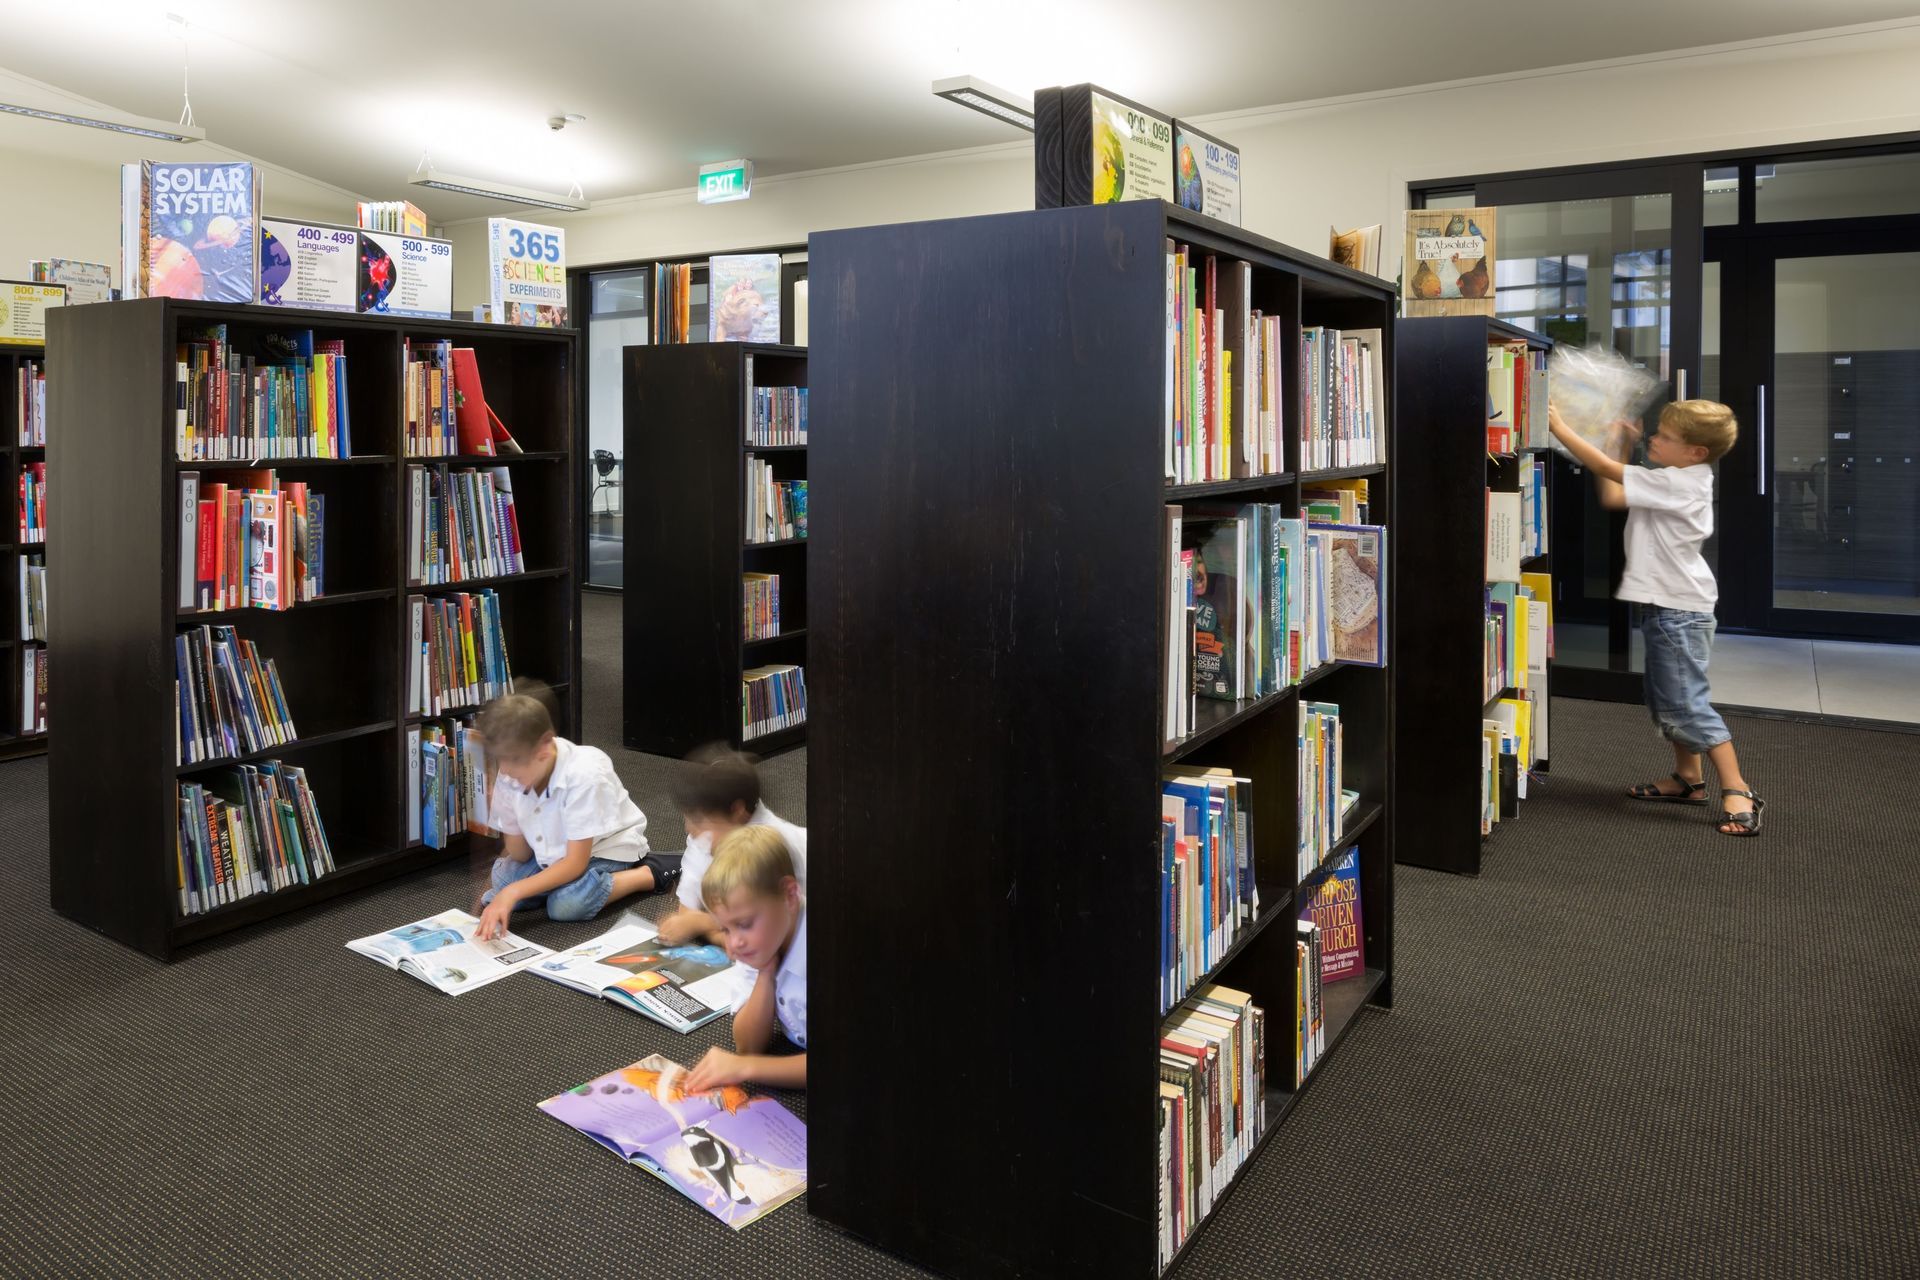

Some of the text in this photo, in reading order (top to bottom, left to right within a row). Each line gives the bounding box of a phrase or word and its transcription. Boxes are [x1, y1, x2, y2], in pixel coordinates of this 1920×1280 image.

[1153, 122, 1169, 143] 099
[1205, 144, 1220, 163] 100
[1225, 152, 1238, 170] 199
[155, 167, 247, 193] SOLAR
[706, 173, 736, 194] EXIT
[155, 192, 247, 215] SYSTEM
[297, 227, 321, 241] 400
[331, 232, 354, 245] 499
[297, 240, 340, 253] Languages
[509, 229, 560, 263] 365
[1419, 240, 1480, 251] It's Absolutely
[402, 241, 422, 253] 500
[431, 245, 449, 257] 599
[402, 252, 427, 262] Science
[1419, 249, 1442, 259] True!
[508, 259, 561, 282] SCIENCE
[14, 286, 34, 295] 800
[43, 288, 62, 296] 899
[509, 283, 561, 299] EXPERIMENTS
[279, 335, 299, 349] facts
[447, 375, 455, 410] TRANSPORT
[186, 484, 194, 523] 400
[308, 499, 320, 560] Collins
[1272, 518, 1280, 575] Young's
[1198, 654, 1221, 663] YOUNG
[206, 804, 224, 884] EXTREME WEATHER
[220, 830, 234, 882] WEATHER
[1306, 878, 1357, 909] PURPOSE
[1311, 902, 1354, 929] DRIVEN
[1319, 925, 1357, 953] HURCH
[1322, 949, 1360, 963] Without Compromising
[1324, 963, 1338, 973] Message
[1341, 960, 1354, 970] Mission
